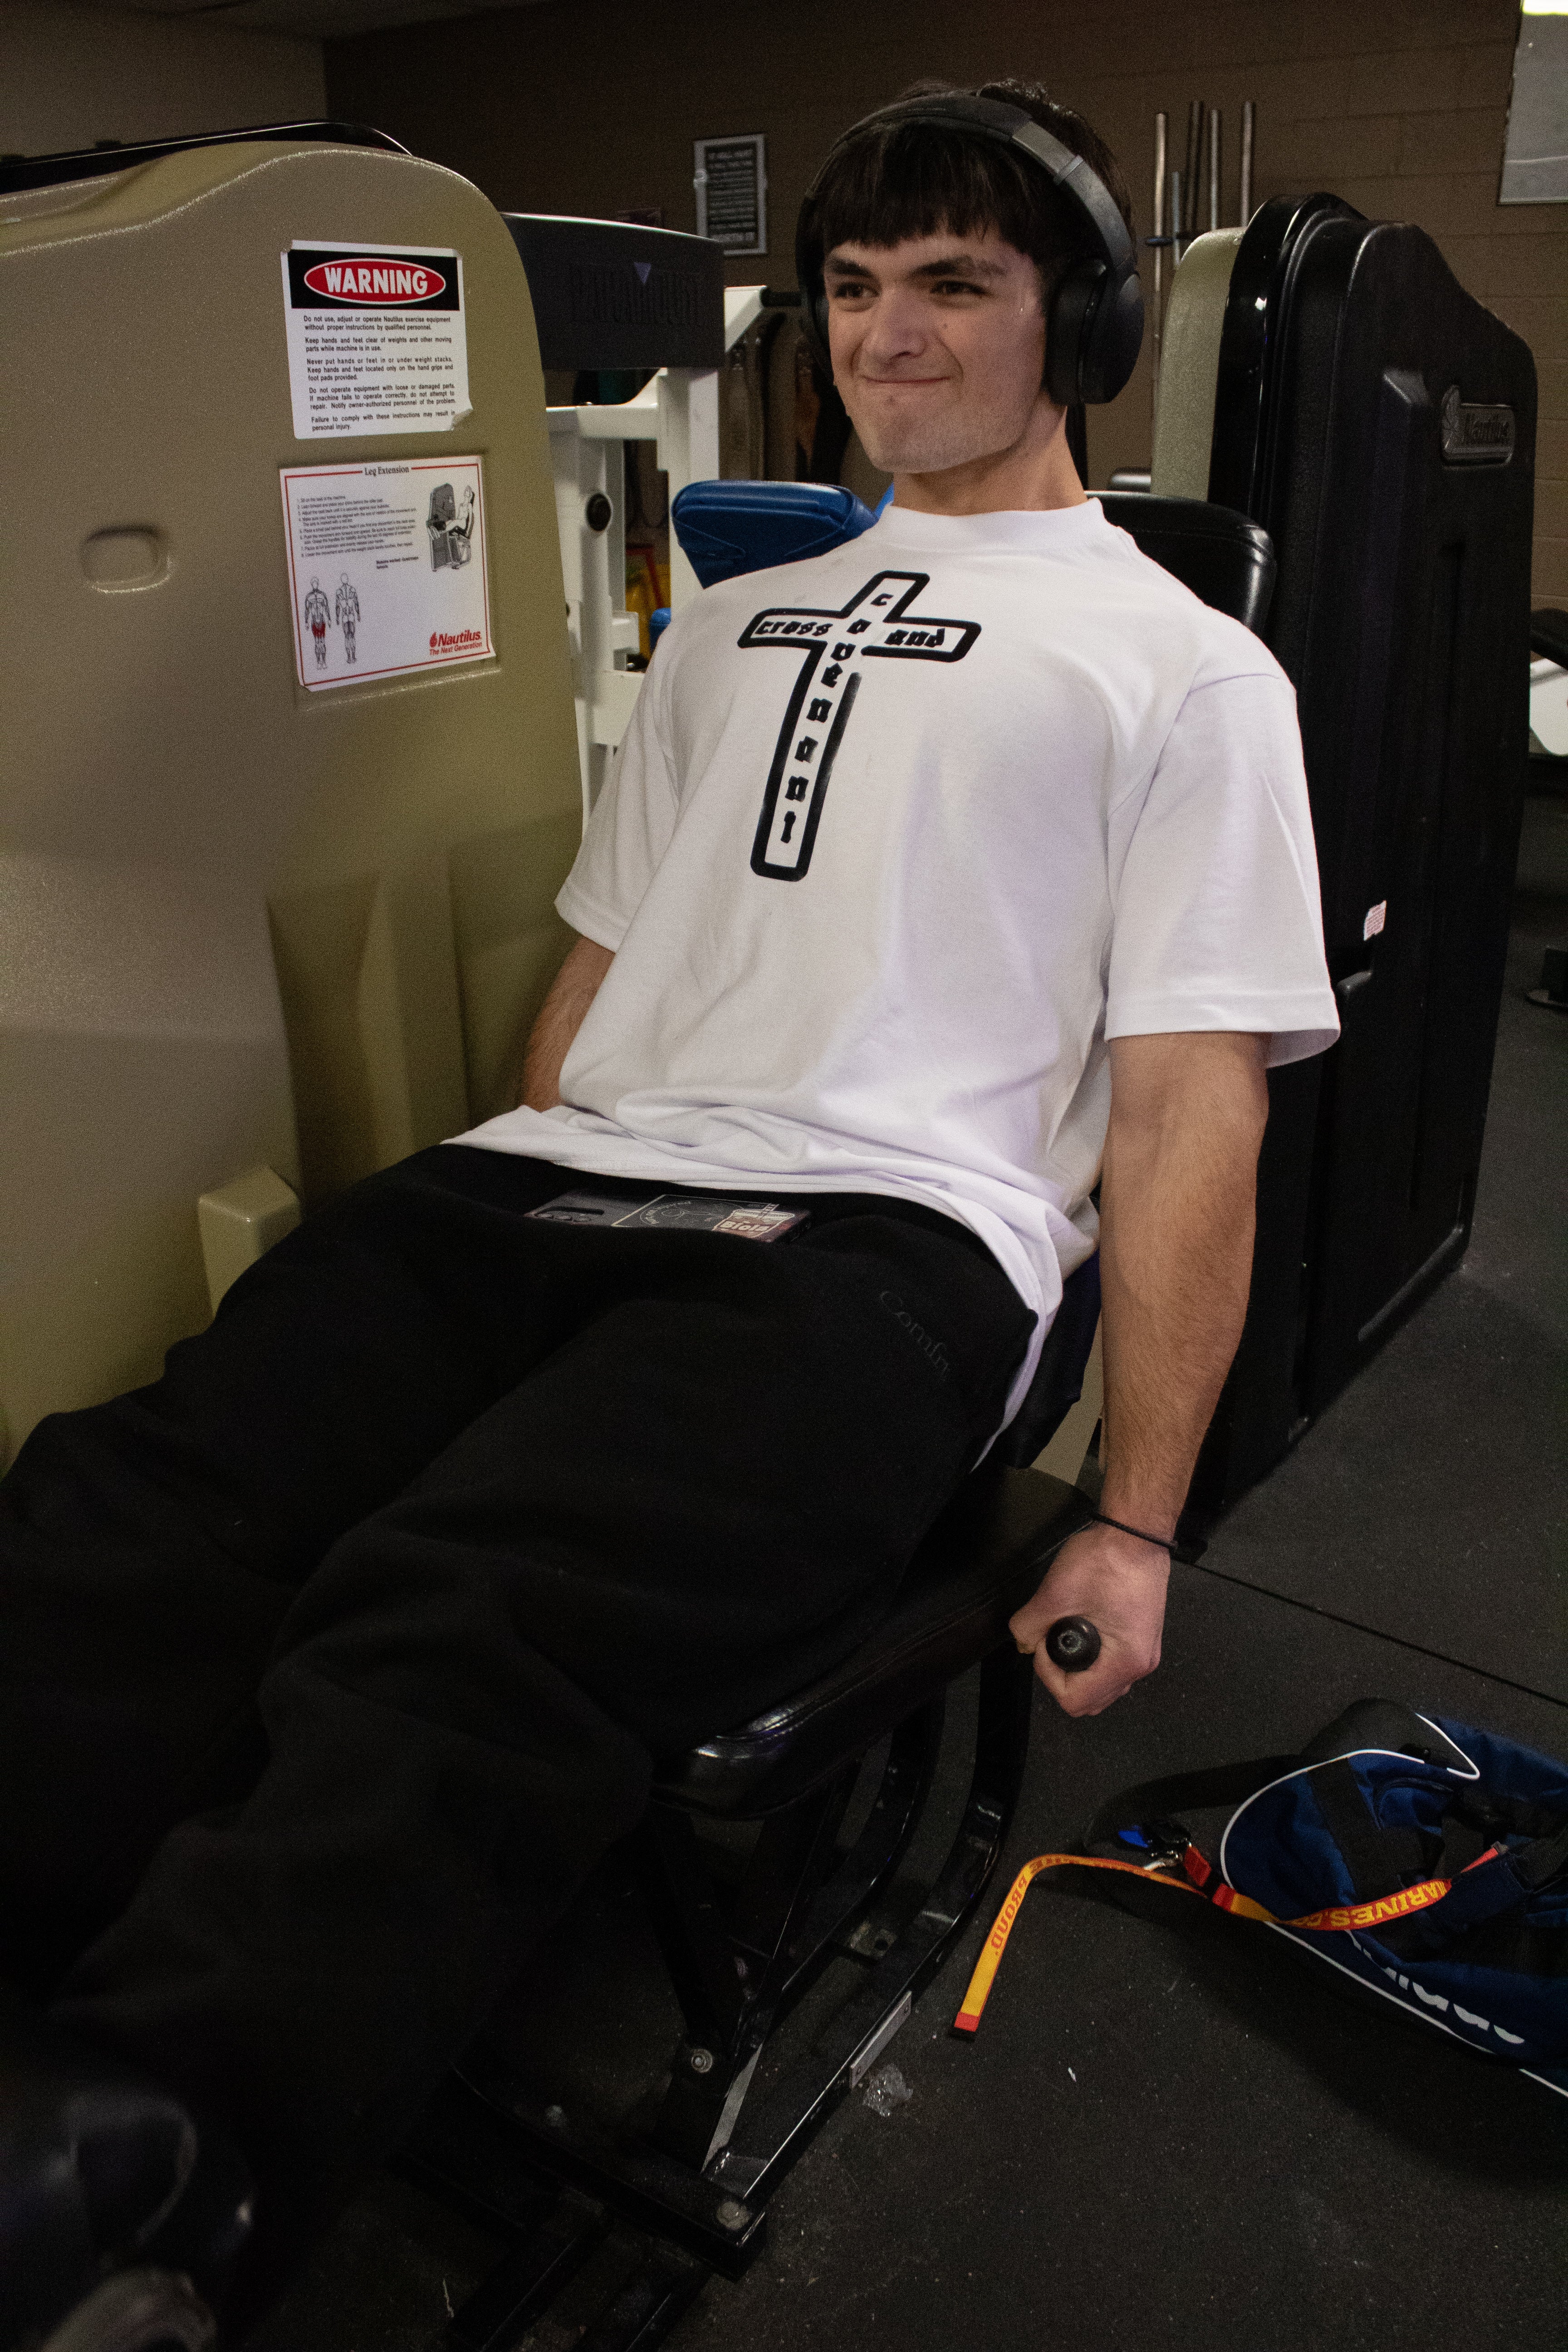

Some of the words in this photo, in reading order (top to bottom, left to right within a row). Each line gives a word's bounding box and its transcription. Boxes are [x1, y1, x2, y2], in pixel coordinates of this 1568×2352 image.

[324, 267, 428, 295] WARNING
[364, 467, 377, 476] Leg
[377, 461, 409, 475] Extension
[755, 621, 833, 637] cross
[884, 627, 946, 647] and
[454, 642, 482, 652] Generation
